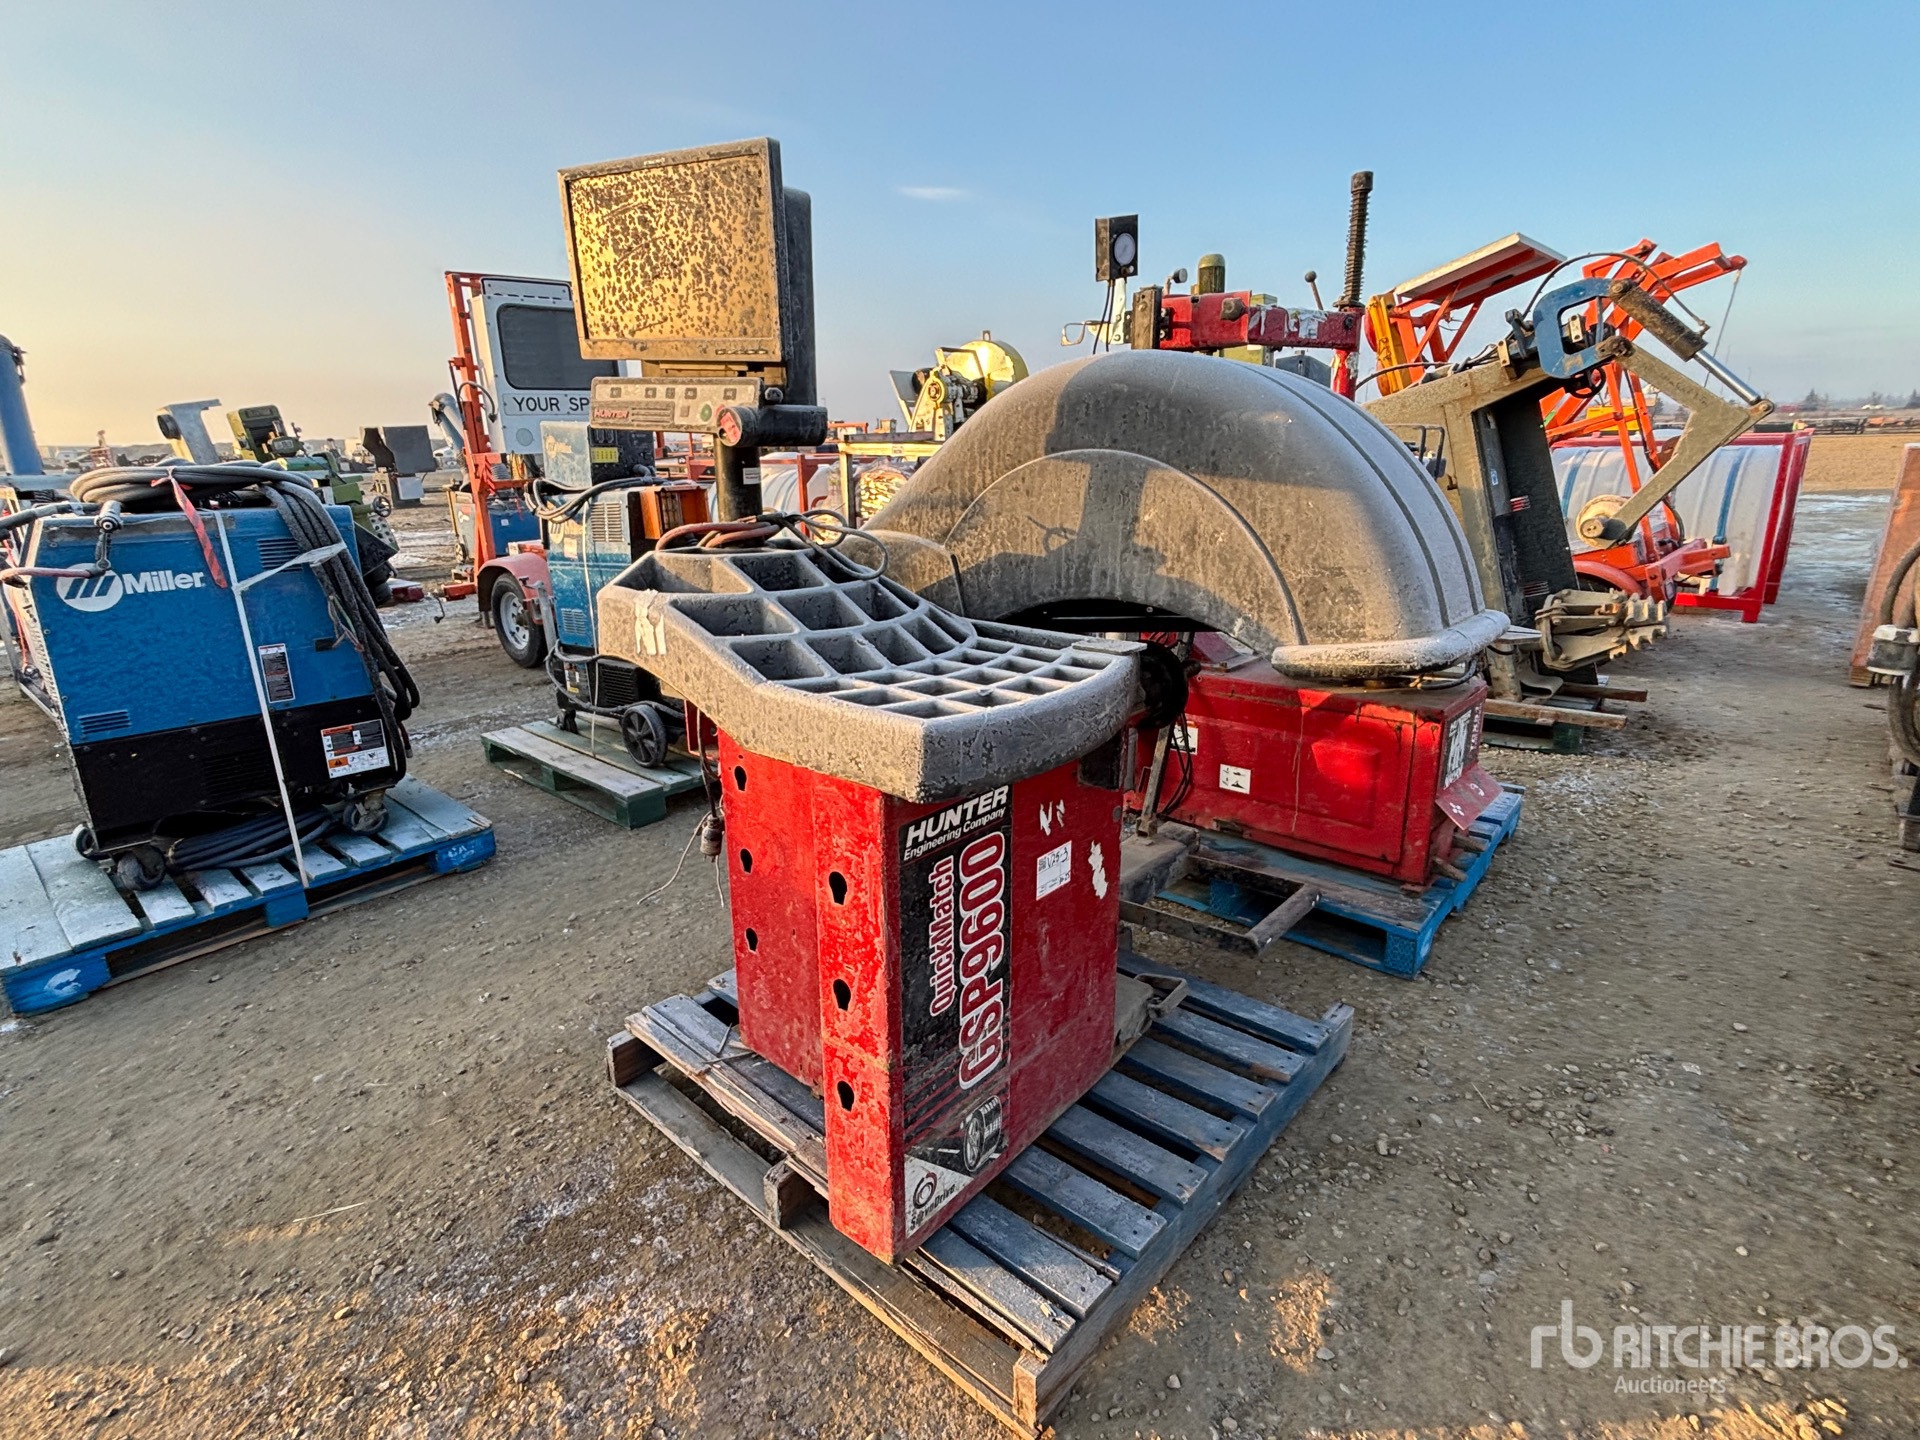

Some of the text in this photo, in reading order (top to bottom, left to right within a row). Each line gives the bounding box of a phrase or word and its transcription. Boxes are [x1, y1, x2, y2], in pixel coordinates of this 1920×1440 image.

[512, 396, 561, 412] YOUR
[121, 570, 204, 595] Miller
[904, 807, 1006, 861] Engineering Company
[905, 785, 1009, 848] HUNTER
[928, 855, 957, 1017] QuickMatch
[959, 831, 1005, 1090] GSP9600
